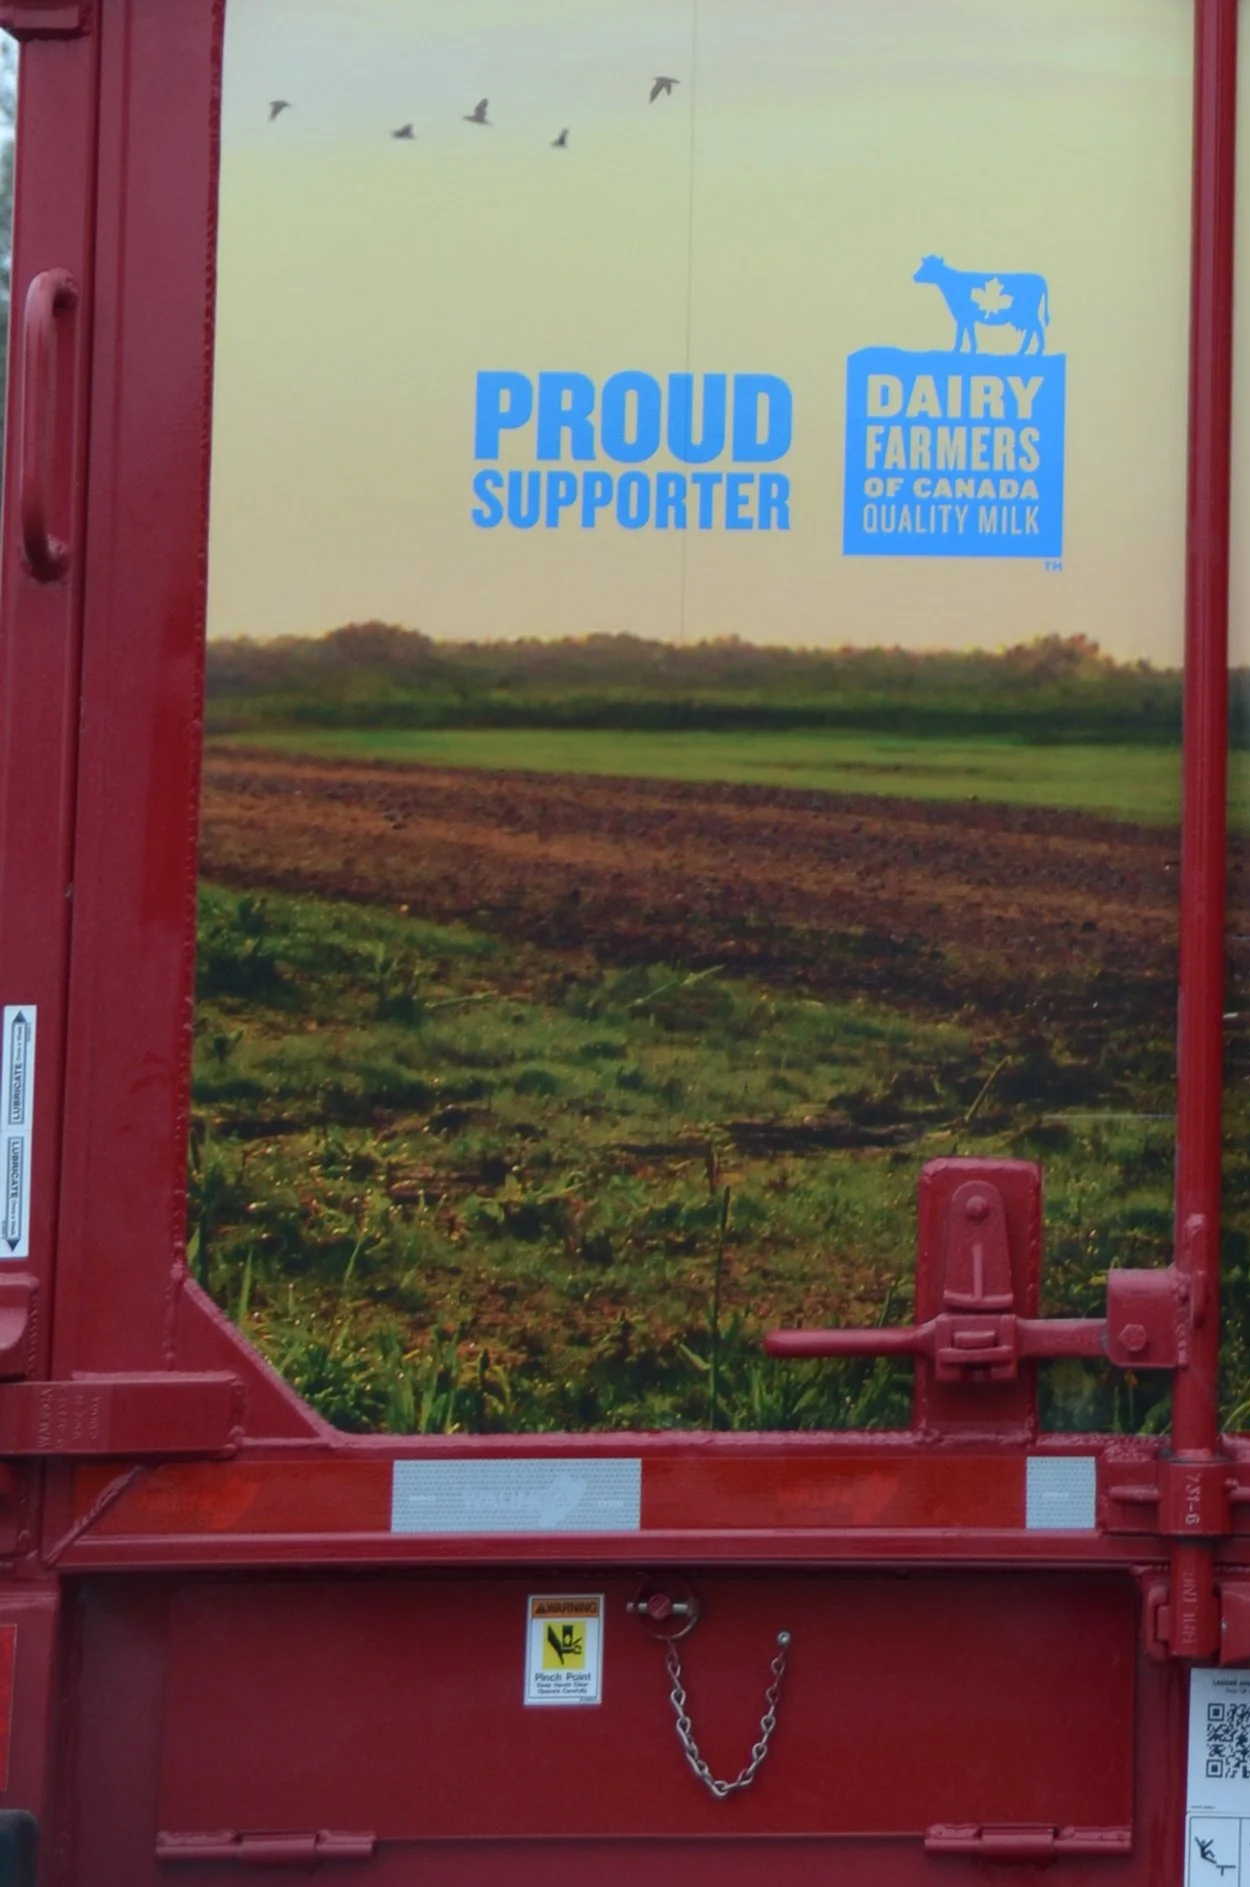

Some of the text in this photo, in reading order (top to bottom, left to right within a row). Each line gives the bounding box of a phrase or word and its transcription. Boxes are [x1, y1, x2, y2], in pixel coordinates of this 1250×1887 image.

[866, 374, 1044, 420] DAIRY
[473, 370, 793, 464] PROUD
[864, 425, 1041, 472] FARMERS
[471, 468, 791, 531] SUPPORTER
[863, 476, 1040, 500] OF CANADA
[862, 504, 1040, 536] QUALITY MILK
[548, 1602, 597, 1614] WARNING
[535, 1672, 591, 1682] Pinch Point
